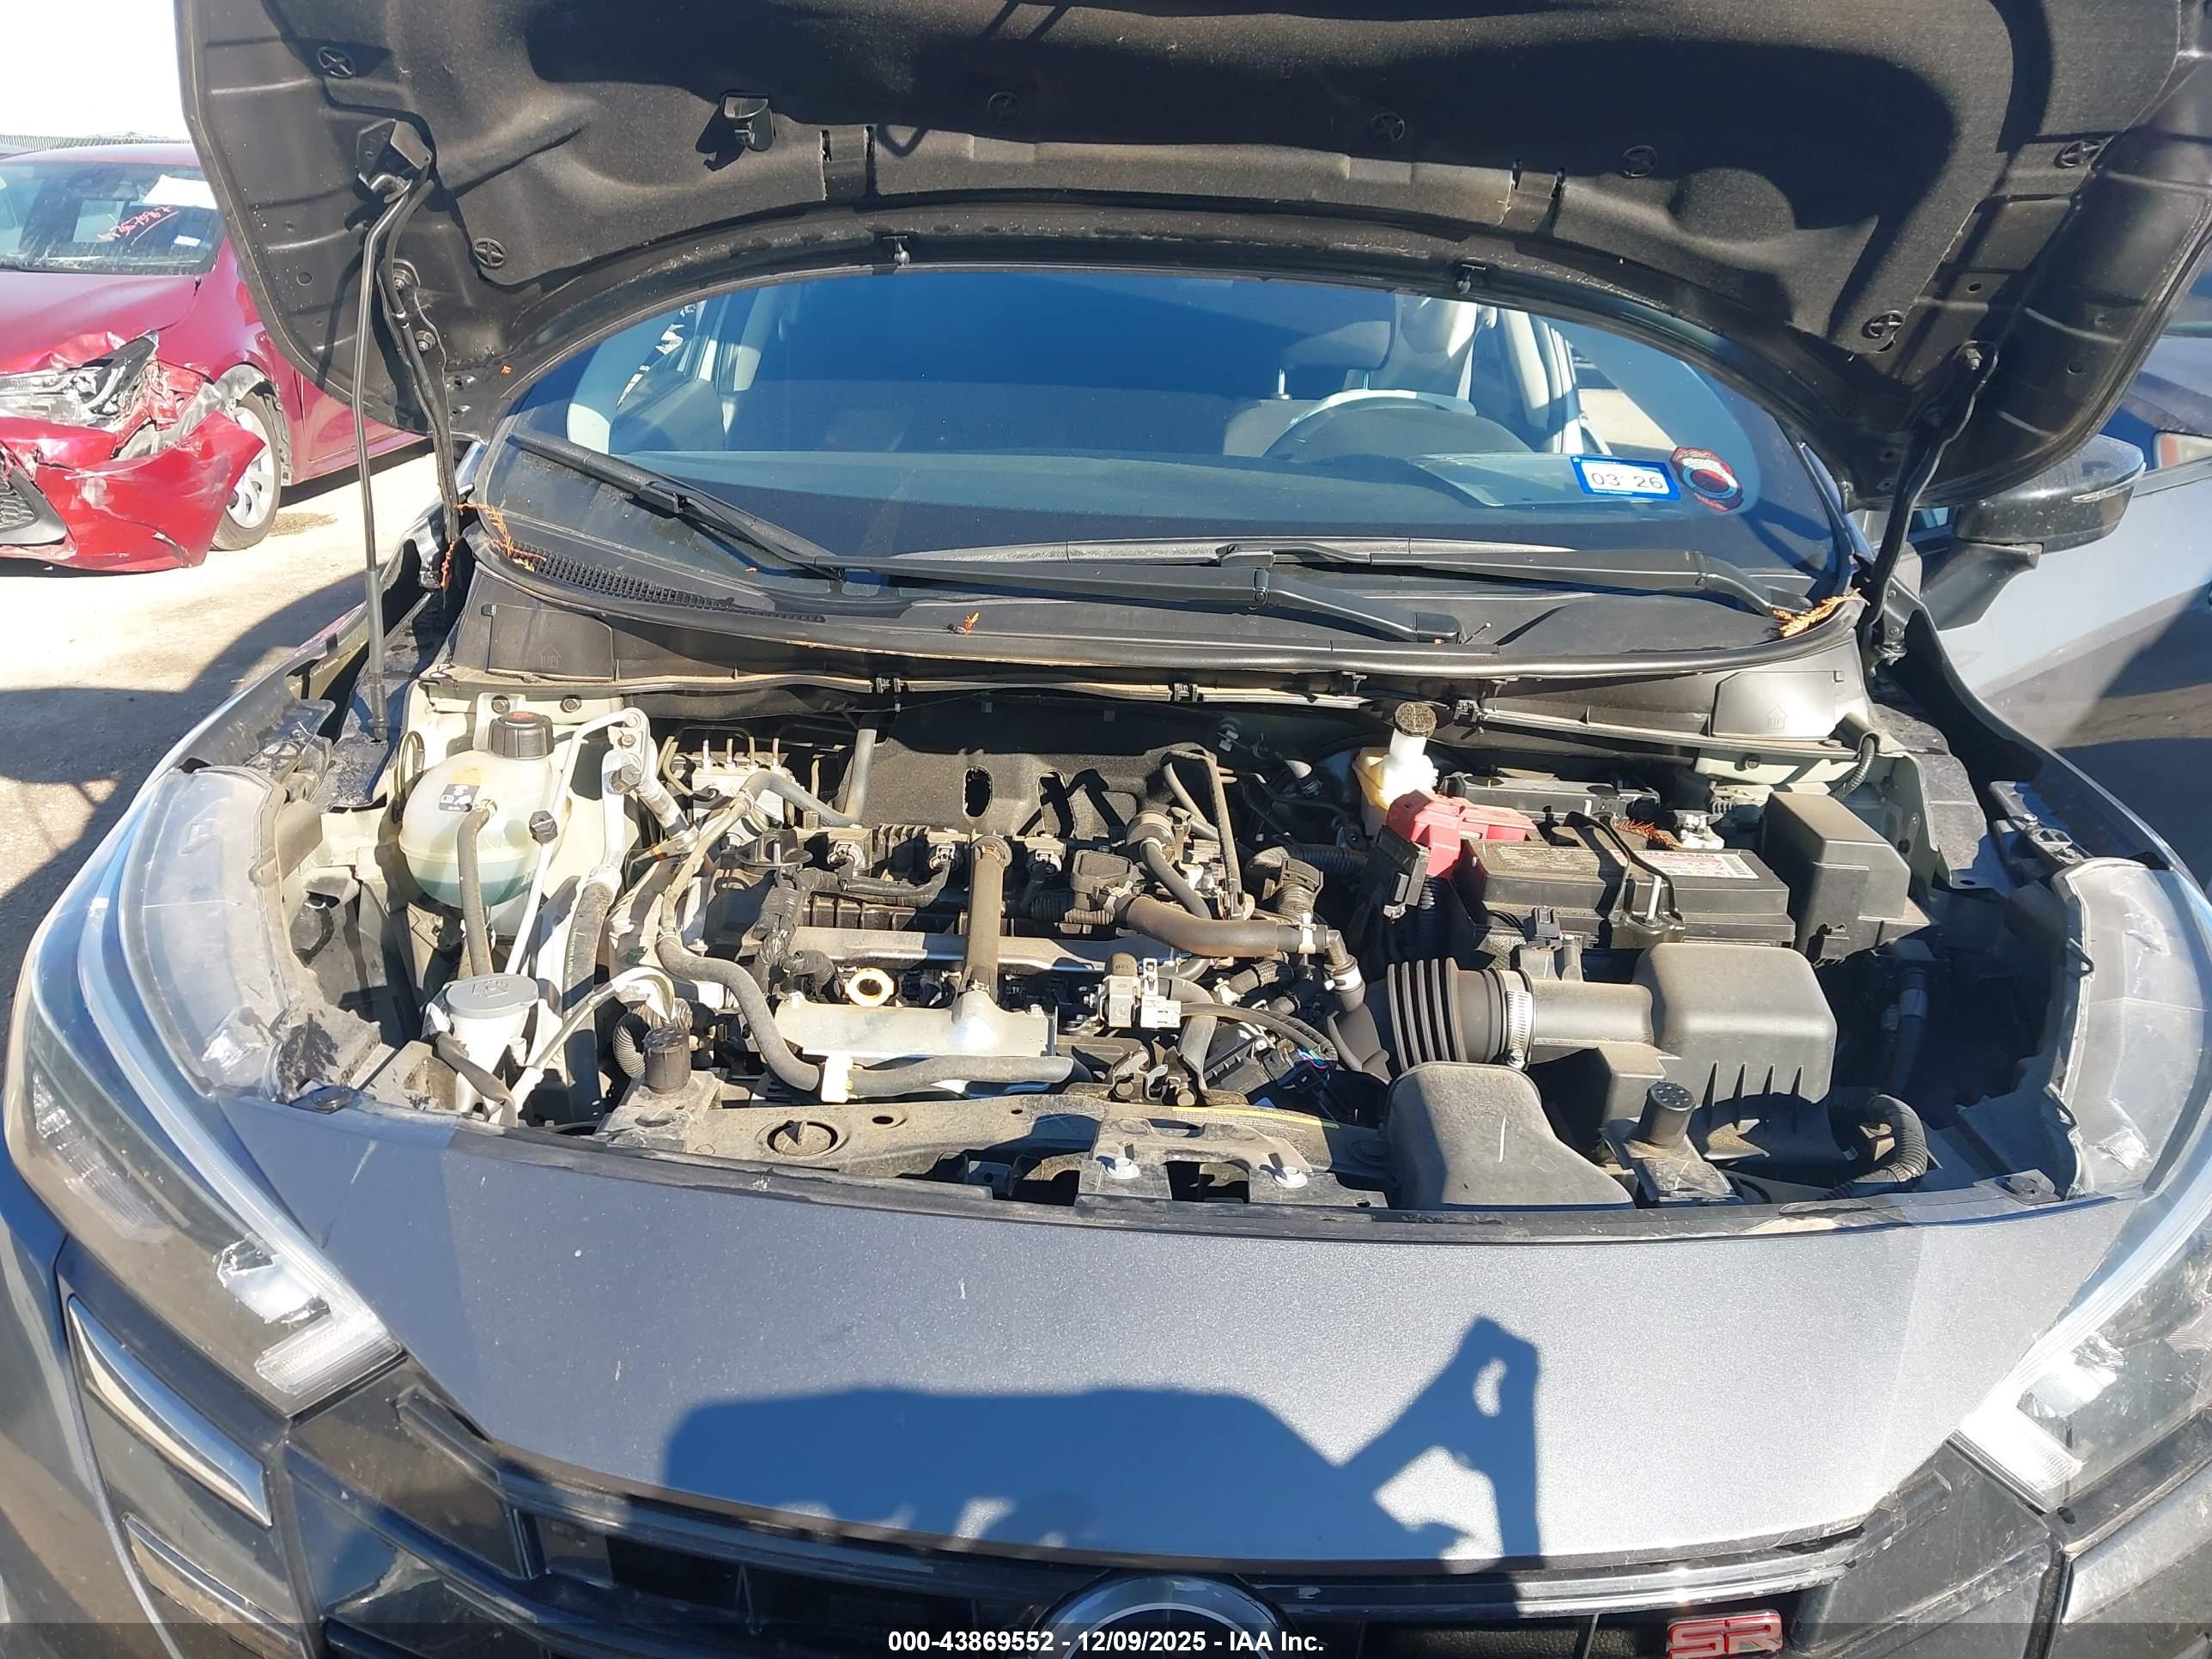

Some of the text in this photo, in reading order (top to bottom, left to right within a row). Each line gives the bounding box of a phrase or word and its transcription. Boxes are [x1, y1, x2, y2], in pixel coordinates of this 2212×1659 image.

[1591, 472, 1663, 489] 03 26
[1668, 1613, 1783, 1659] SR
